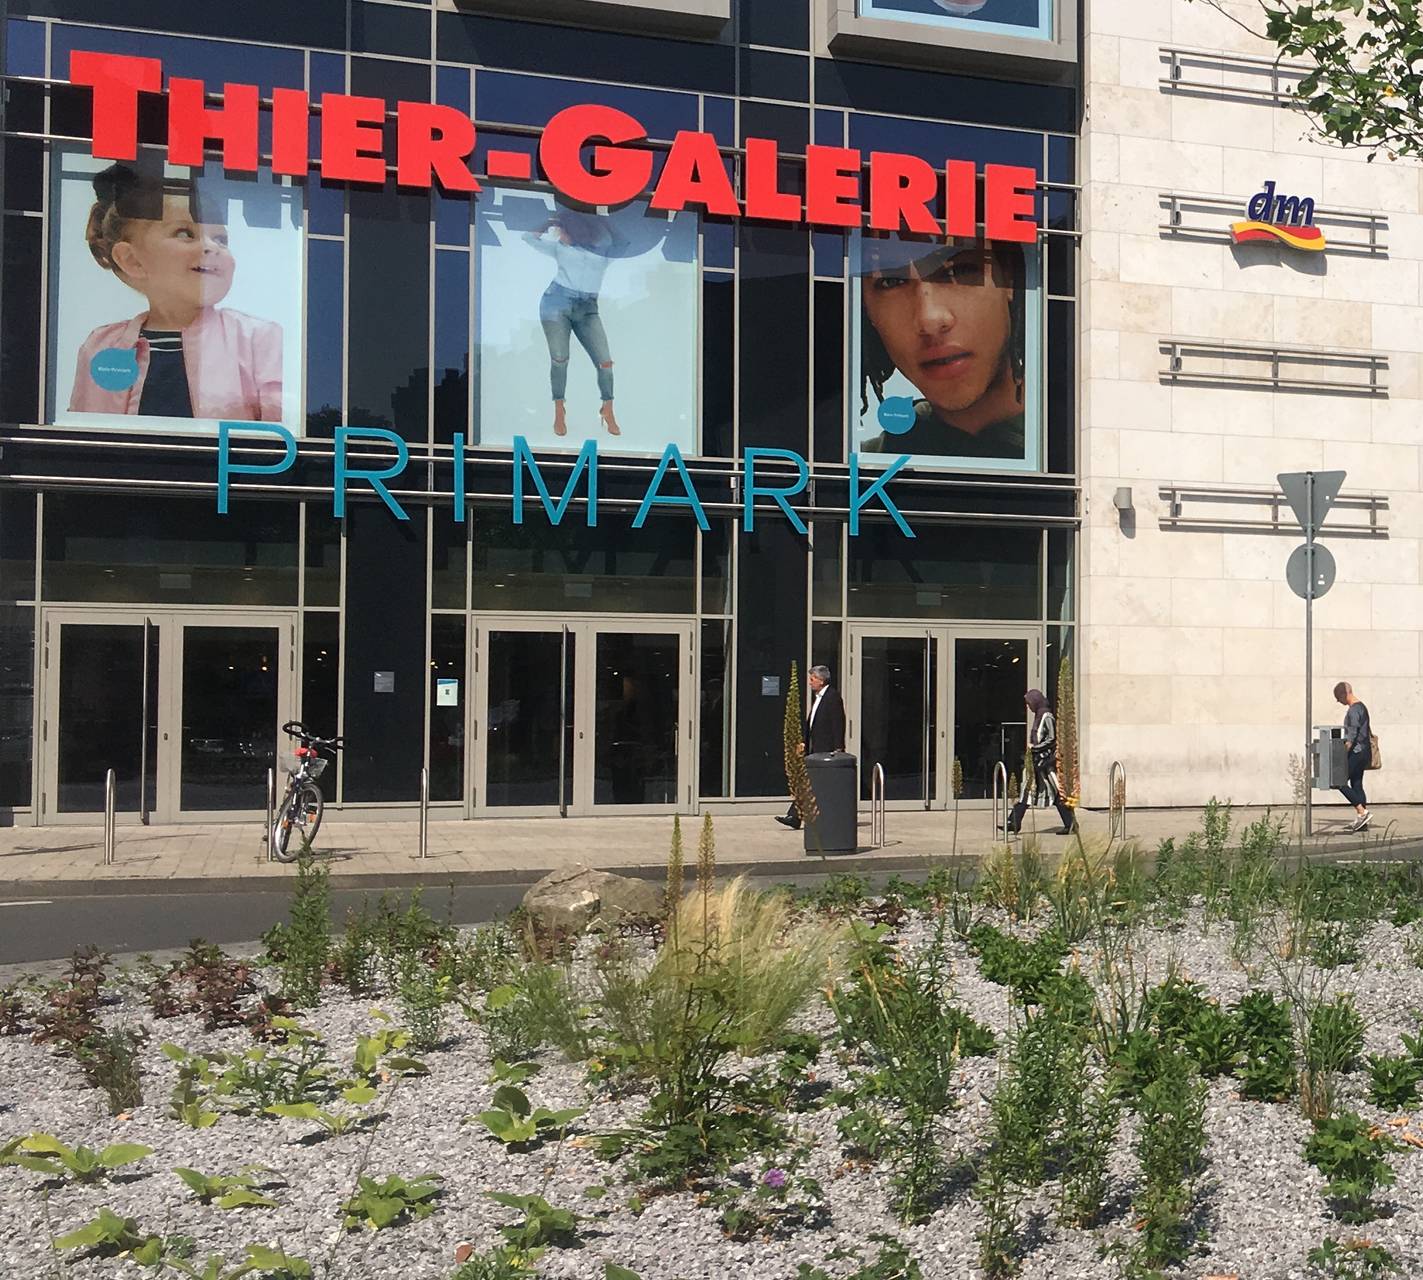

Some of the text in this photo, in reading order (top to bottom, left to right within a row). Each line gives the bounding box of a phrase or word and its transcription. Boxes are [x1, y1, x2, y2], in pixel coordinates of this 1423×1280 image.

[70, 50, 1039, 244] THIER-GALERIE
[1247, 180, 1315, 226] dm
[217, 420, 917, 540] PRIMARK
